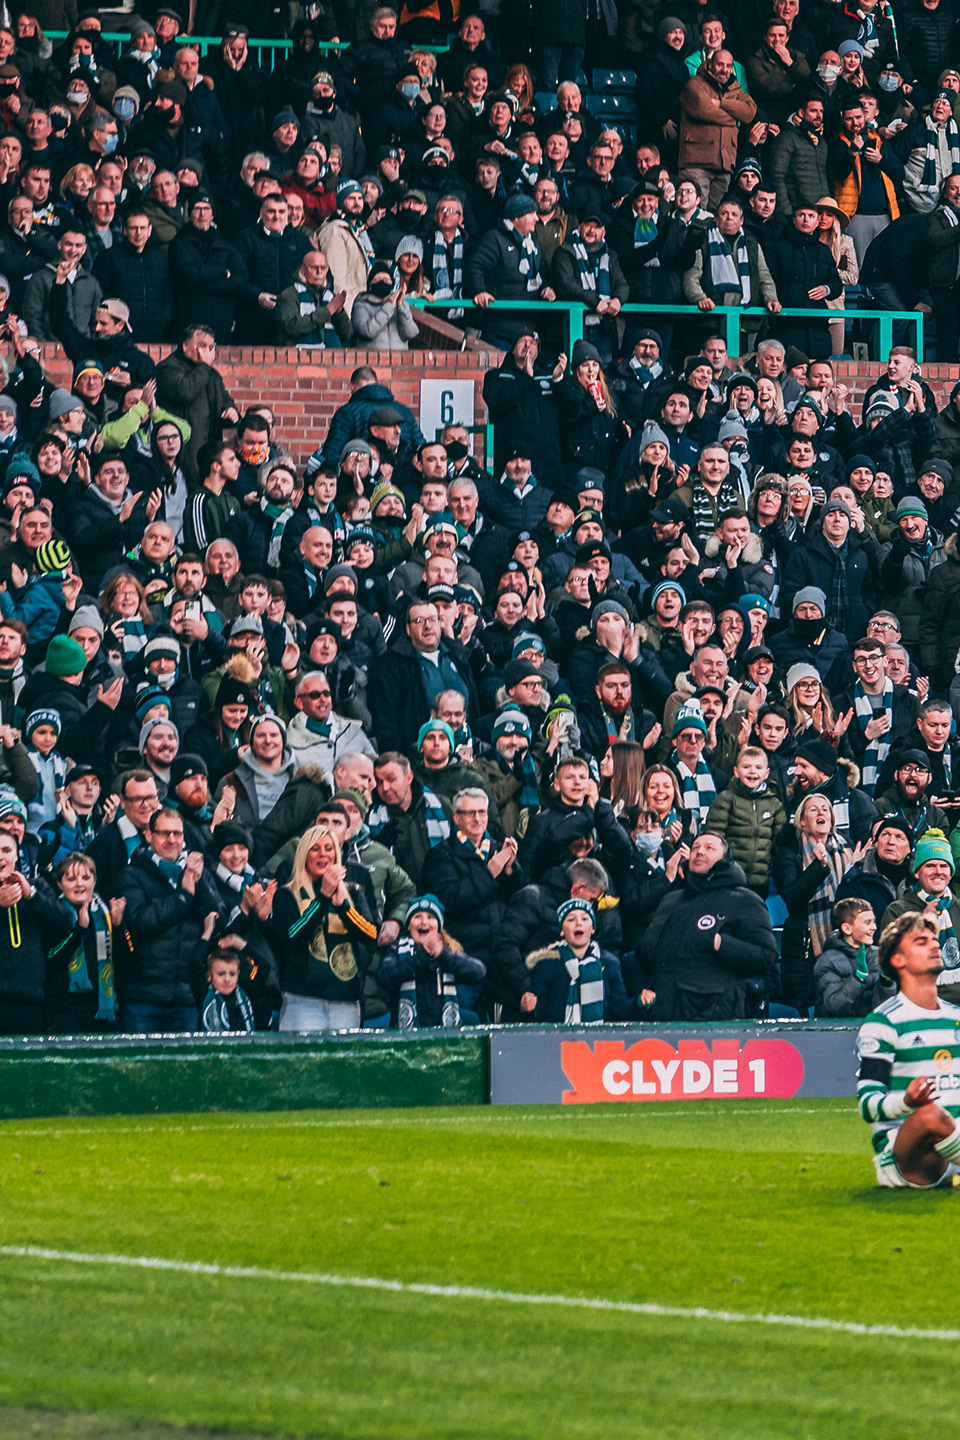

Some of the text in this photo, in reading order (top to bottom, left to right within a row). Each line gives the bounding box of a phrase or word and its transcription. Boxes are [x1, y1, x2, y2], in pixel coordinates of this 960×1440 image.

[440, 390, 454, 425] 6
[602, 1059, 766, 1096] CLYDE 1
